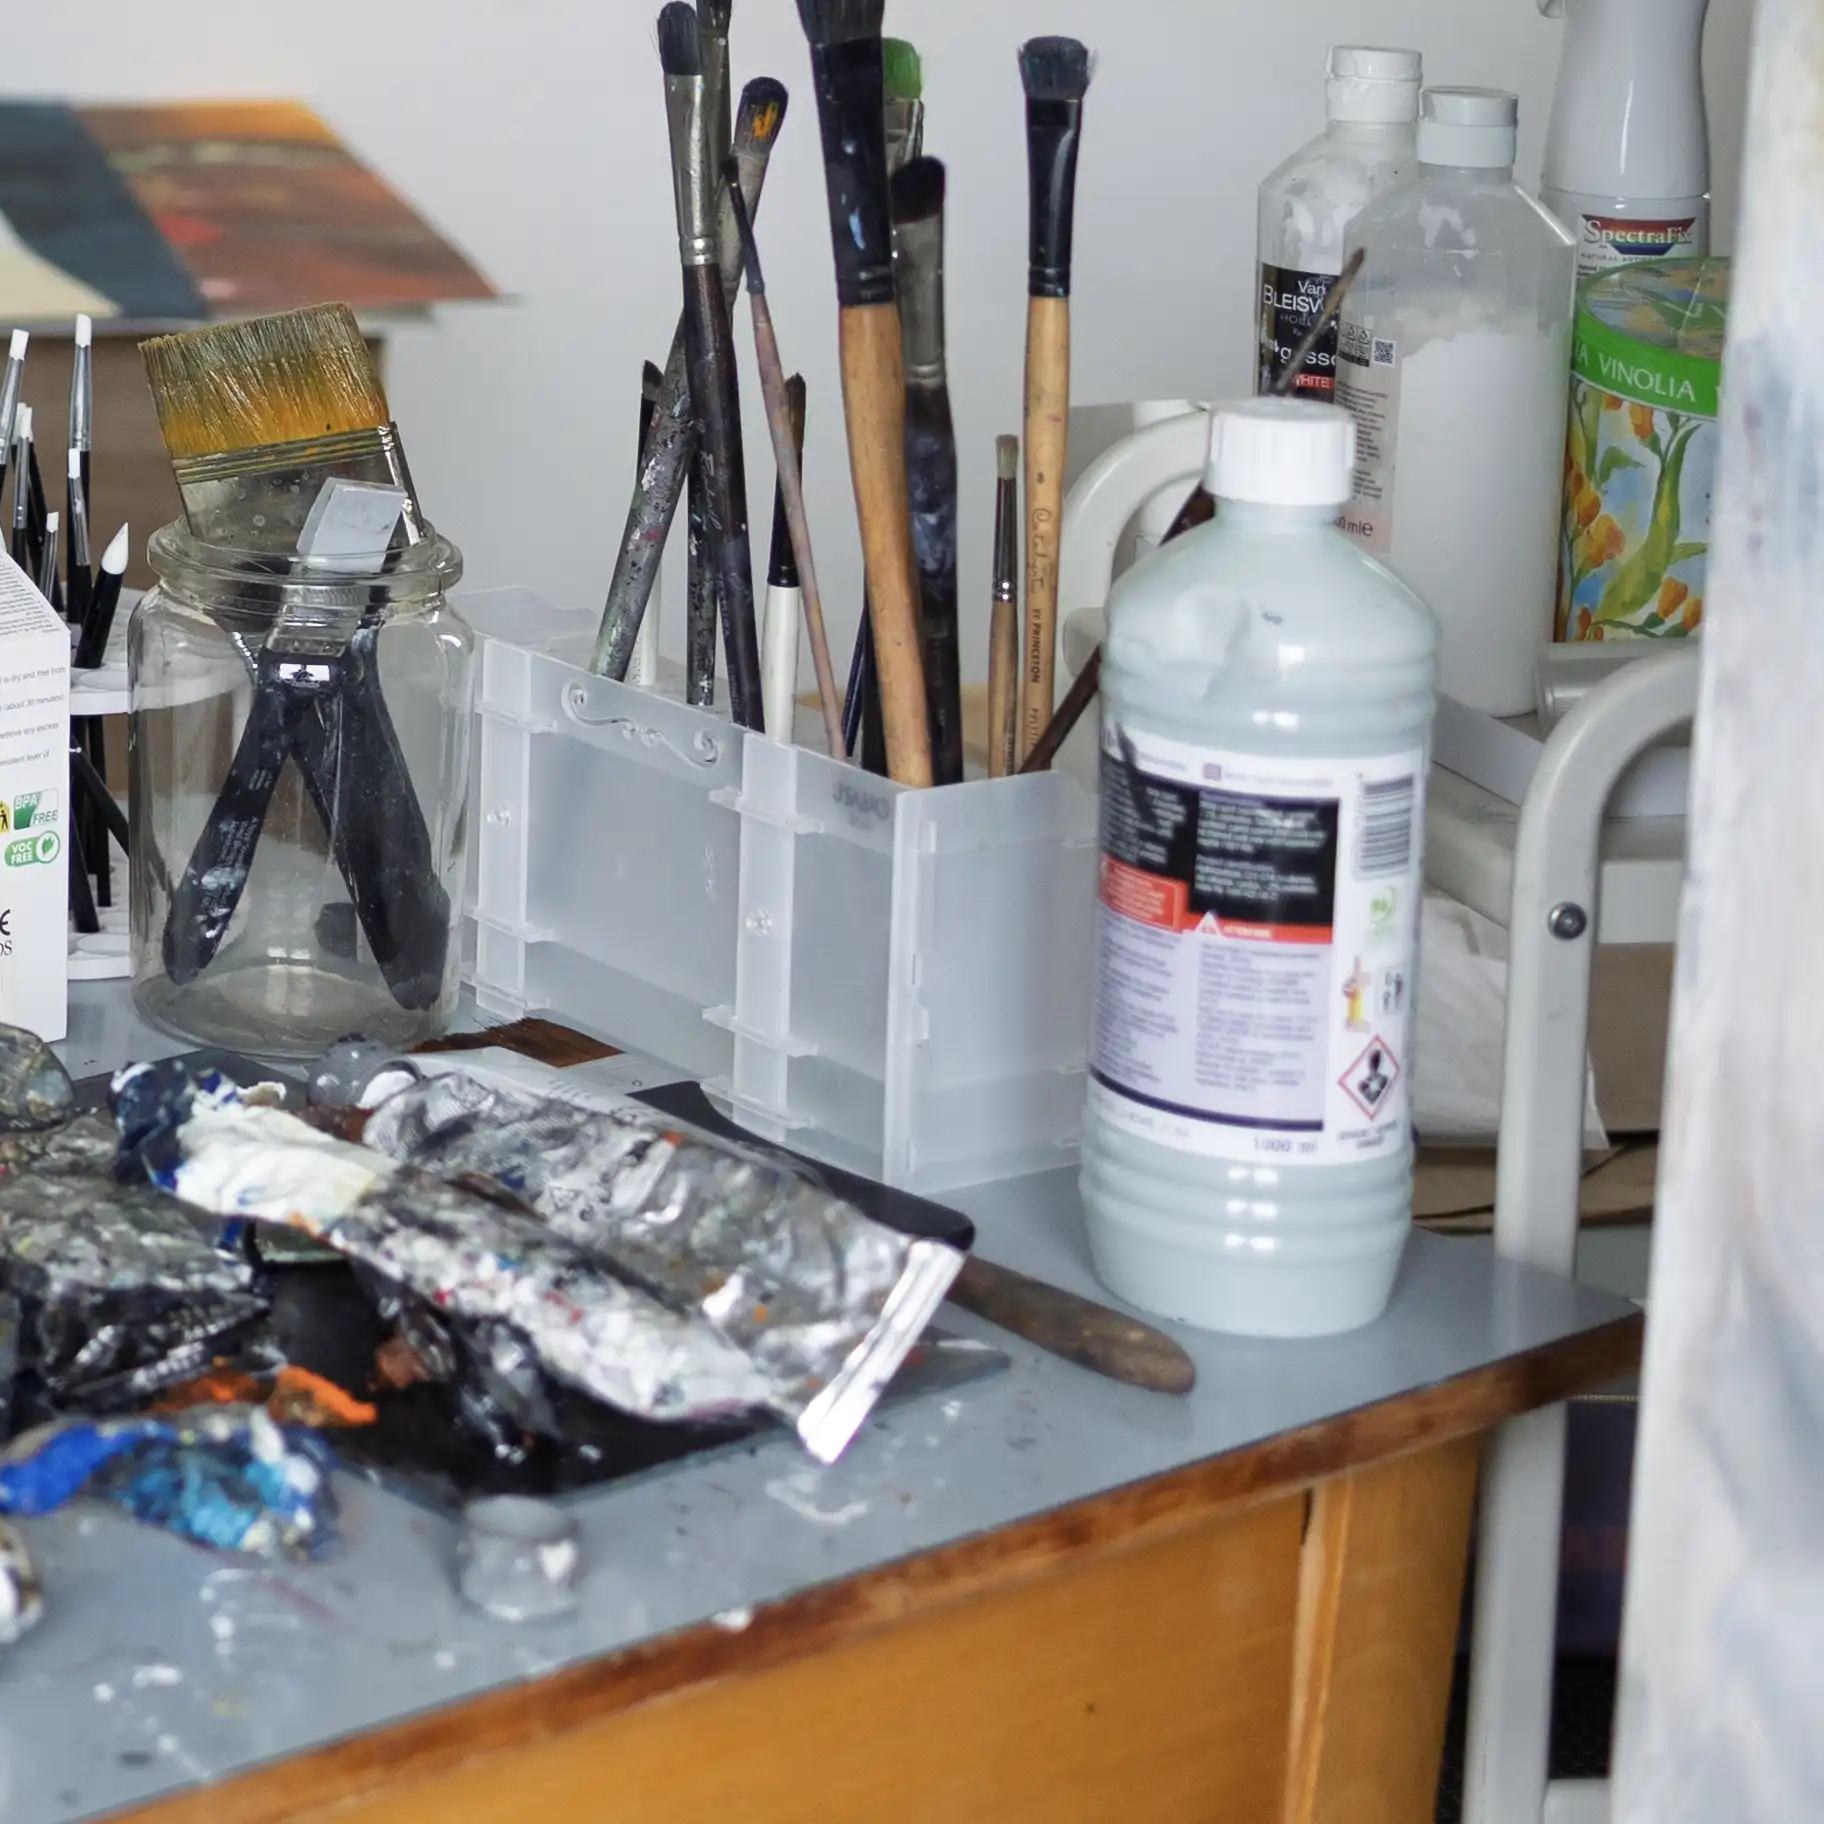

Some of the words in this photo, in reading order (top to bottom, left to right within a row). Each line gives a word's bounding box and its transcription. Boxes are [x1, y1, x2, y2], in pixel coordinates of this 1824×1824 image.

[1584, 219, 1693, 245] SpectraFix
[1298, 280, 1326, 295] Van
[1598, 352, 1697, 403] VINOLIA
[1032, 608, 1041, 623] BY
[1030, 623, 1042, 684] PRINCETON
[15, 796, 37, 811] BPA
[33, 809, 59, 826] FREE
[11, 841, 32, 854] VOC
[11, 851, 33, 864] FREE
